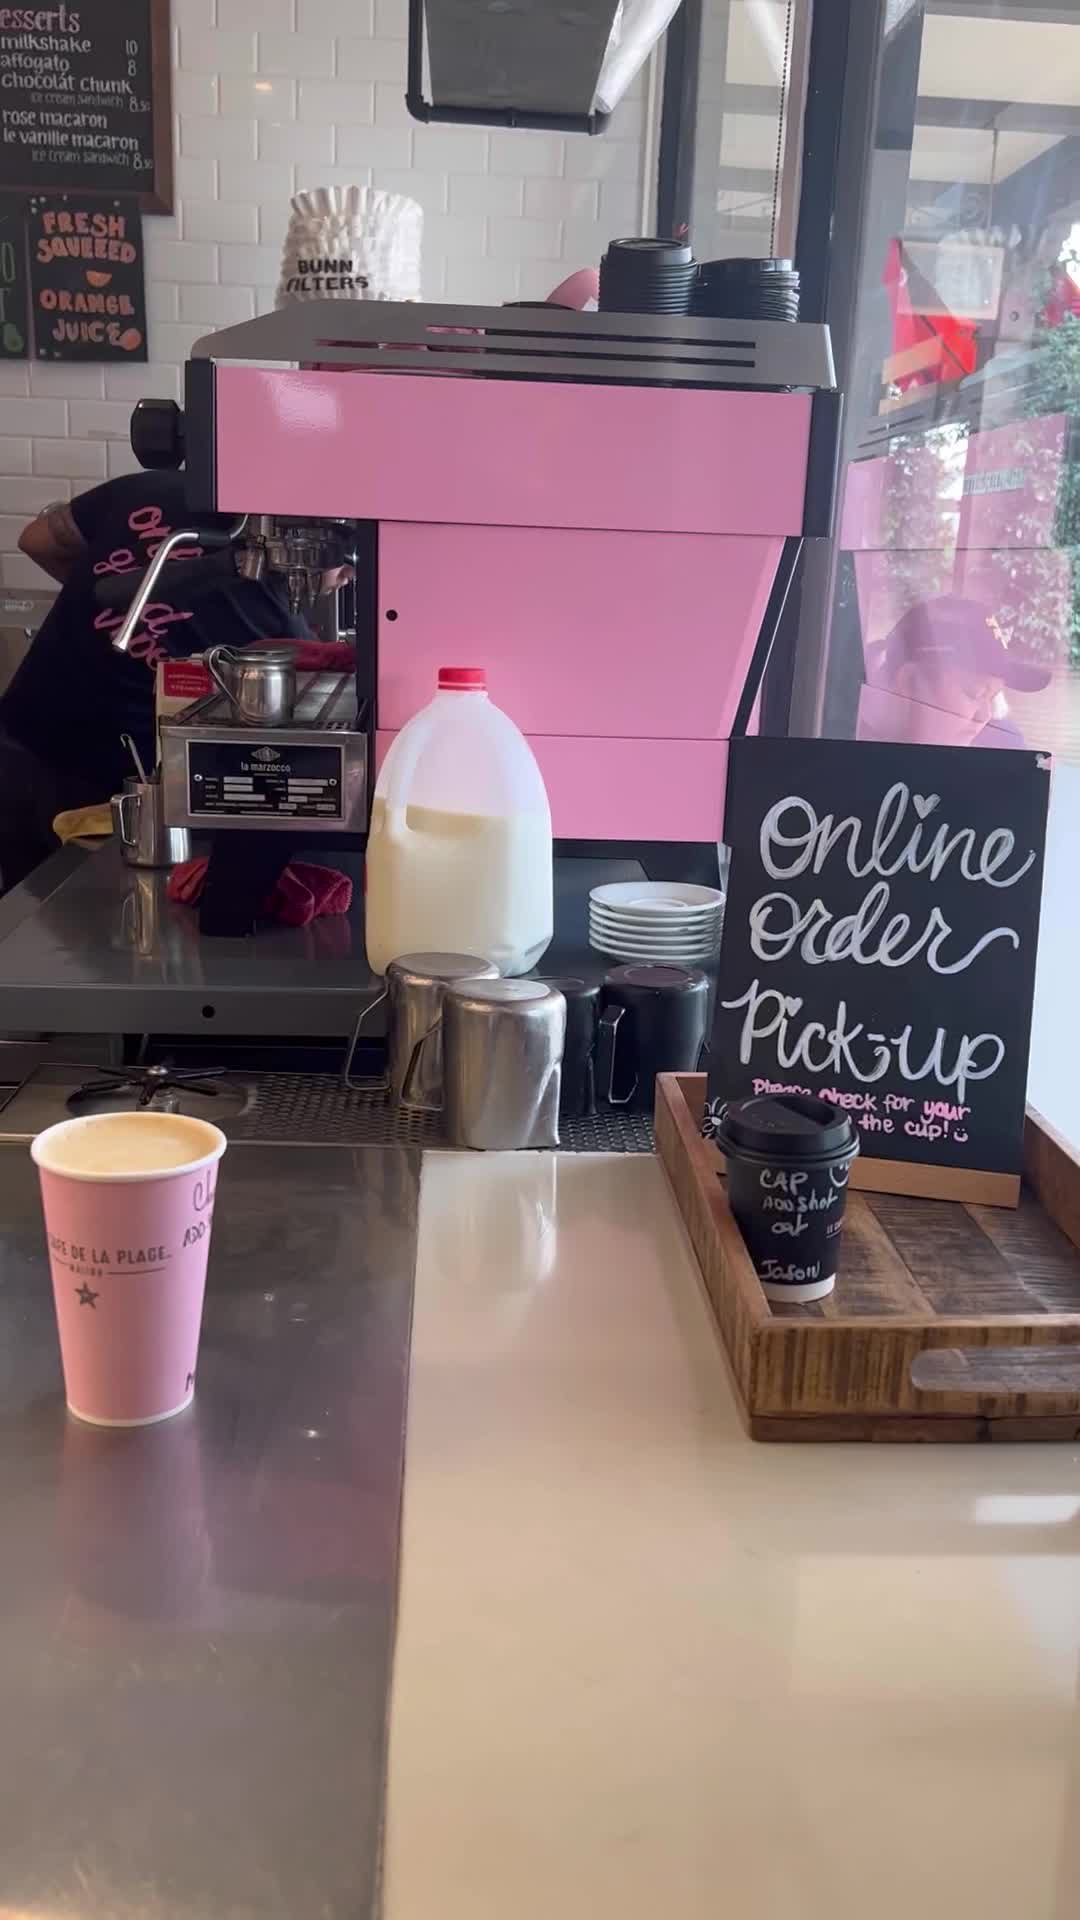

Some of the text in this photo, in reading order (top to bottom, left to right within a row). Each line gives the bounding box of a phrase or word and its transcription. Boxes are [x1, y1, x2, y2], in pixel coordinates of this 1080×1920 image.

[1, 34, 138, 56] milkshake 10
[0, 53, 137, 77] affogato 8
[80, 77, 133, 94] chunk
[2, 110, 108, 129] rose macaron
[3, 127, 139, 150] le vanille macaron
[42, 211, 126, 239] FRESH
[297, 259, 353, 274] BUNN
[39, 288, 135, 316] ORANGE
[52, 318, 123, 346] JUICE
[250, 762, 292, 773] marzocco
[759, 782, 1037, 888] Online
[882, 1093, 916, 1114] for
[920, 1100, 972, 1125] your
[857, 1113, 896, 1134] the
[760, 1168, 809, 1195] CAP
[71, 1245, 86, 1262] DE
[92, 1248, 110, 1264] LA
[117, 1245, 165, 1265] PLAGE
